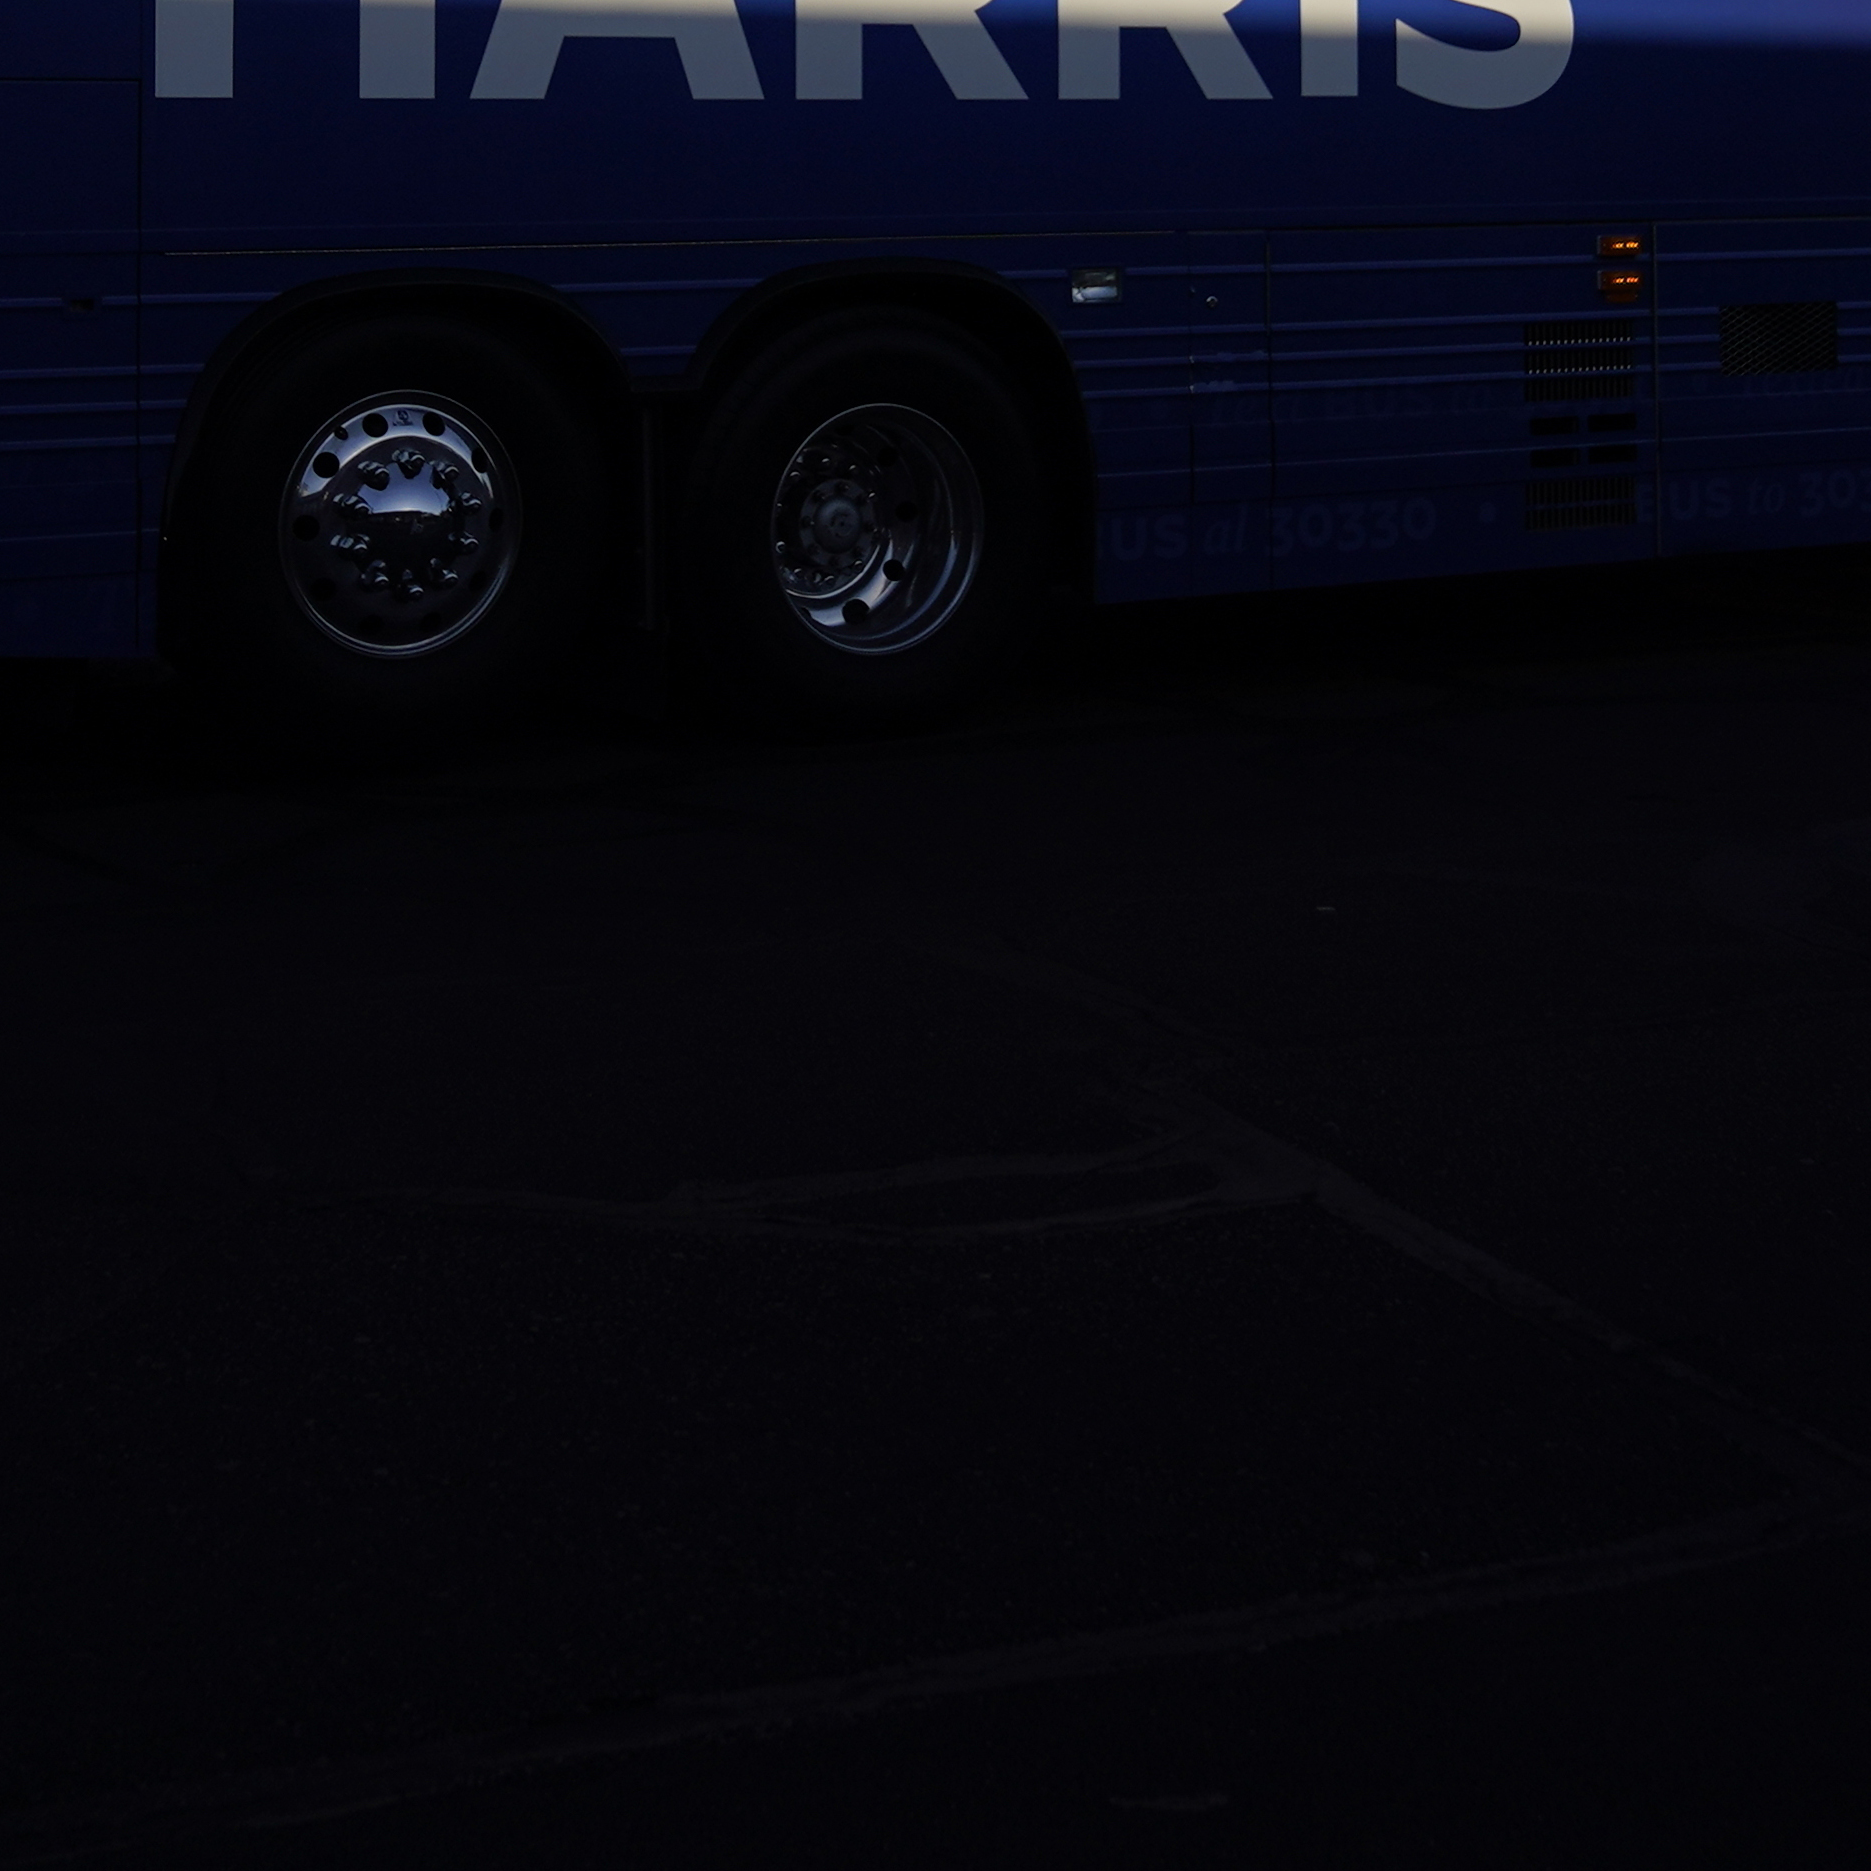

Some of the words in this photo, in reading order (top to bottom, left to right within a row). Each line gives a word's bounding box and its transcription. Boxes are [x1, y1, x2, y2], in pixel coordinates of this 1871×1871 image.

[1203, 500, 1249, 555] al
[1263, 496, 1438, 560] 30330
[1746, 476, 1786, 515] to
